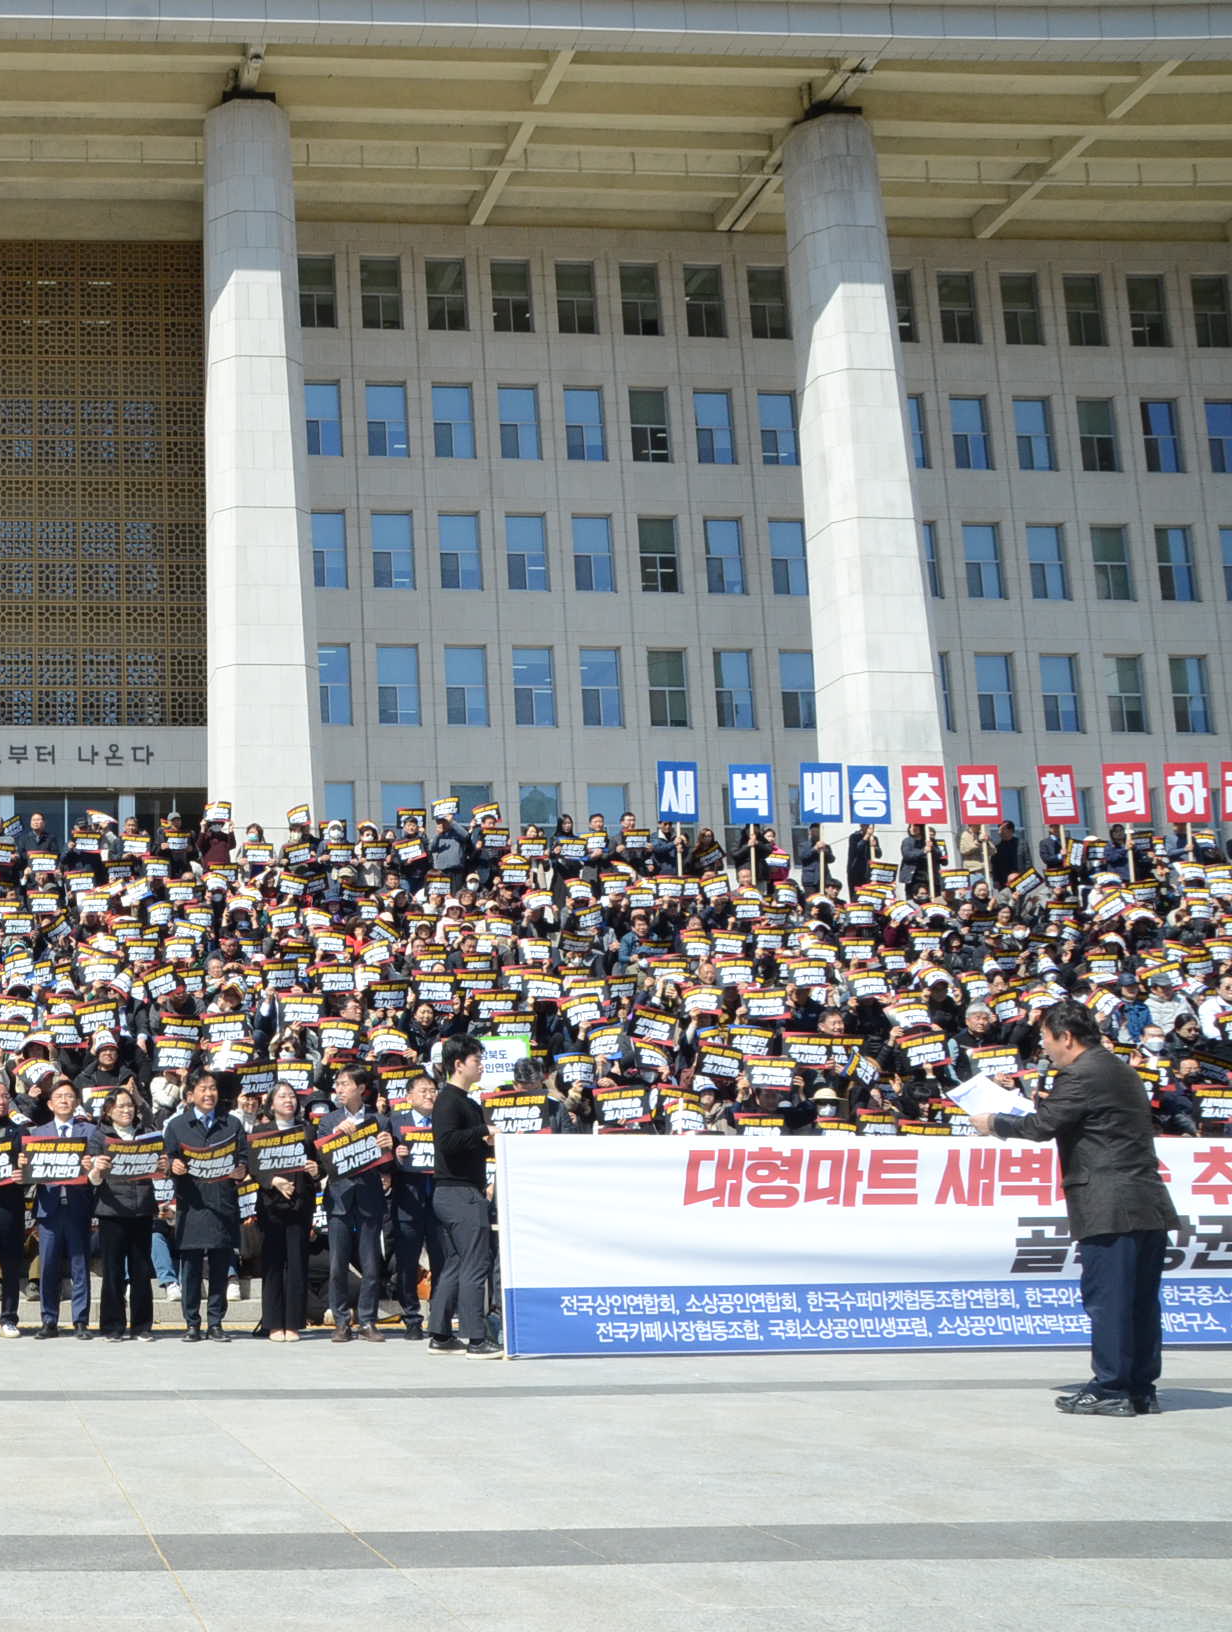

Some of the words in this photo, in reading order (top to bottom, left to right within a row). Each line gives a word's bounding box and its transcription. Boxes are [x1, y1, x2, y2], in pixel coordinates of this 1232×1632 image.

[78, 743, 155, 767] 나온다
[492, 1106, 541, 1121] 새벽배송
[494, 1119, 542, 1133] 결사반대
[257, 1144, 305, 1161] 새벽배송
[332, 1136, 377, 1163] 새벽배송
[30, 1152, 80, 1166] 새벽배송
[112, 1152, 158, 1166] 새벽배송
[259, 1155, 307, 1171] 결사반대
[336, 1148, 381, 1174] 결사반대
[32, 1165, 79, 1178] 결사반대
[110, 1163, 157, 1177] 결사반대
[684, 1147, 918, 1208] 대형마트
[560, 1294, 680, 1316] 전국상인연합회,
[685, 1292, 802, 1314] 소상공인연합회,
[807, 1289, 1020, 1313] 한국수퍼마켓협동조합연합회,
[596, 1321, 764, 1342] 전국카페사장협동조합,
[769, 1317, 932, 1339] 국회소상공인민생포럼,
